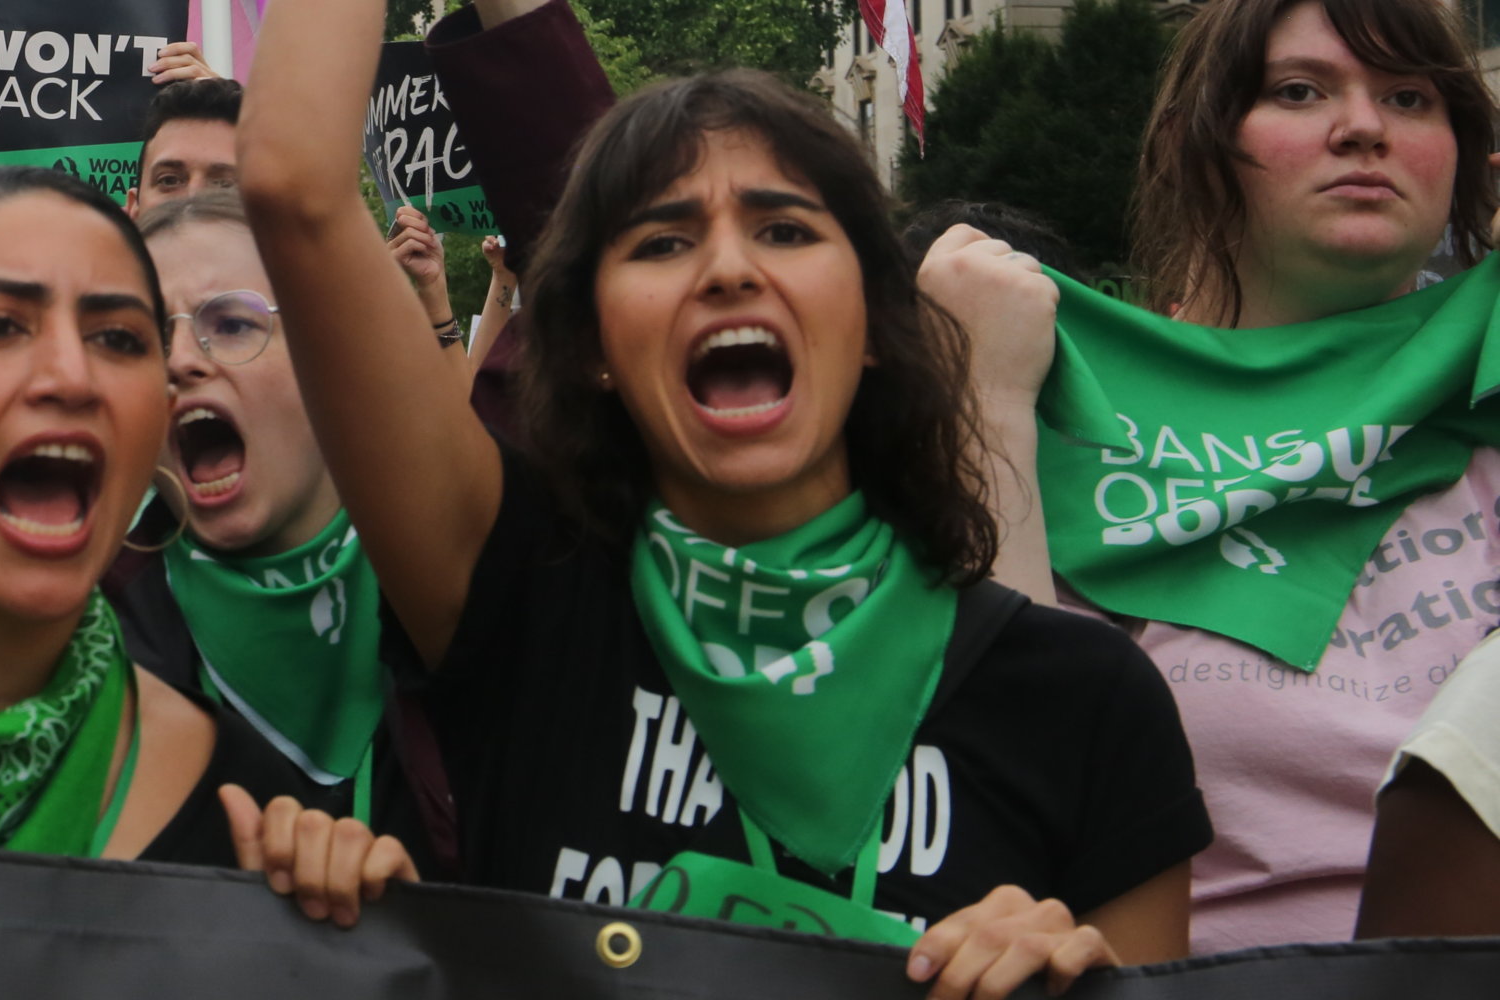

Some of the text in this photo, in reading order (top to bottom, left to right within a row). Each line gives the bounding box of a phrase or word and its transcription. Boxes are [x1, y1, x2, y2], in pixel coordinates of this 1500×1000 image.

[89, 157, 137, 174] WOM
[384, 121, 473, 212] RAG
[1168, 657, 1413, 703] destigmatize
[619, 685, 724, 827] THA
